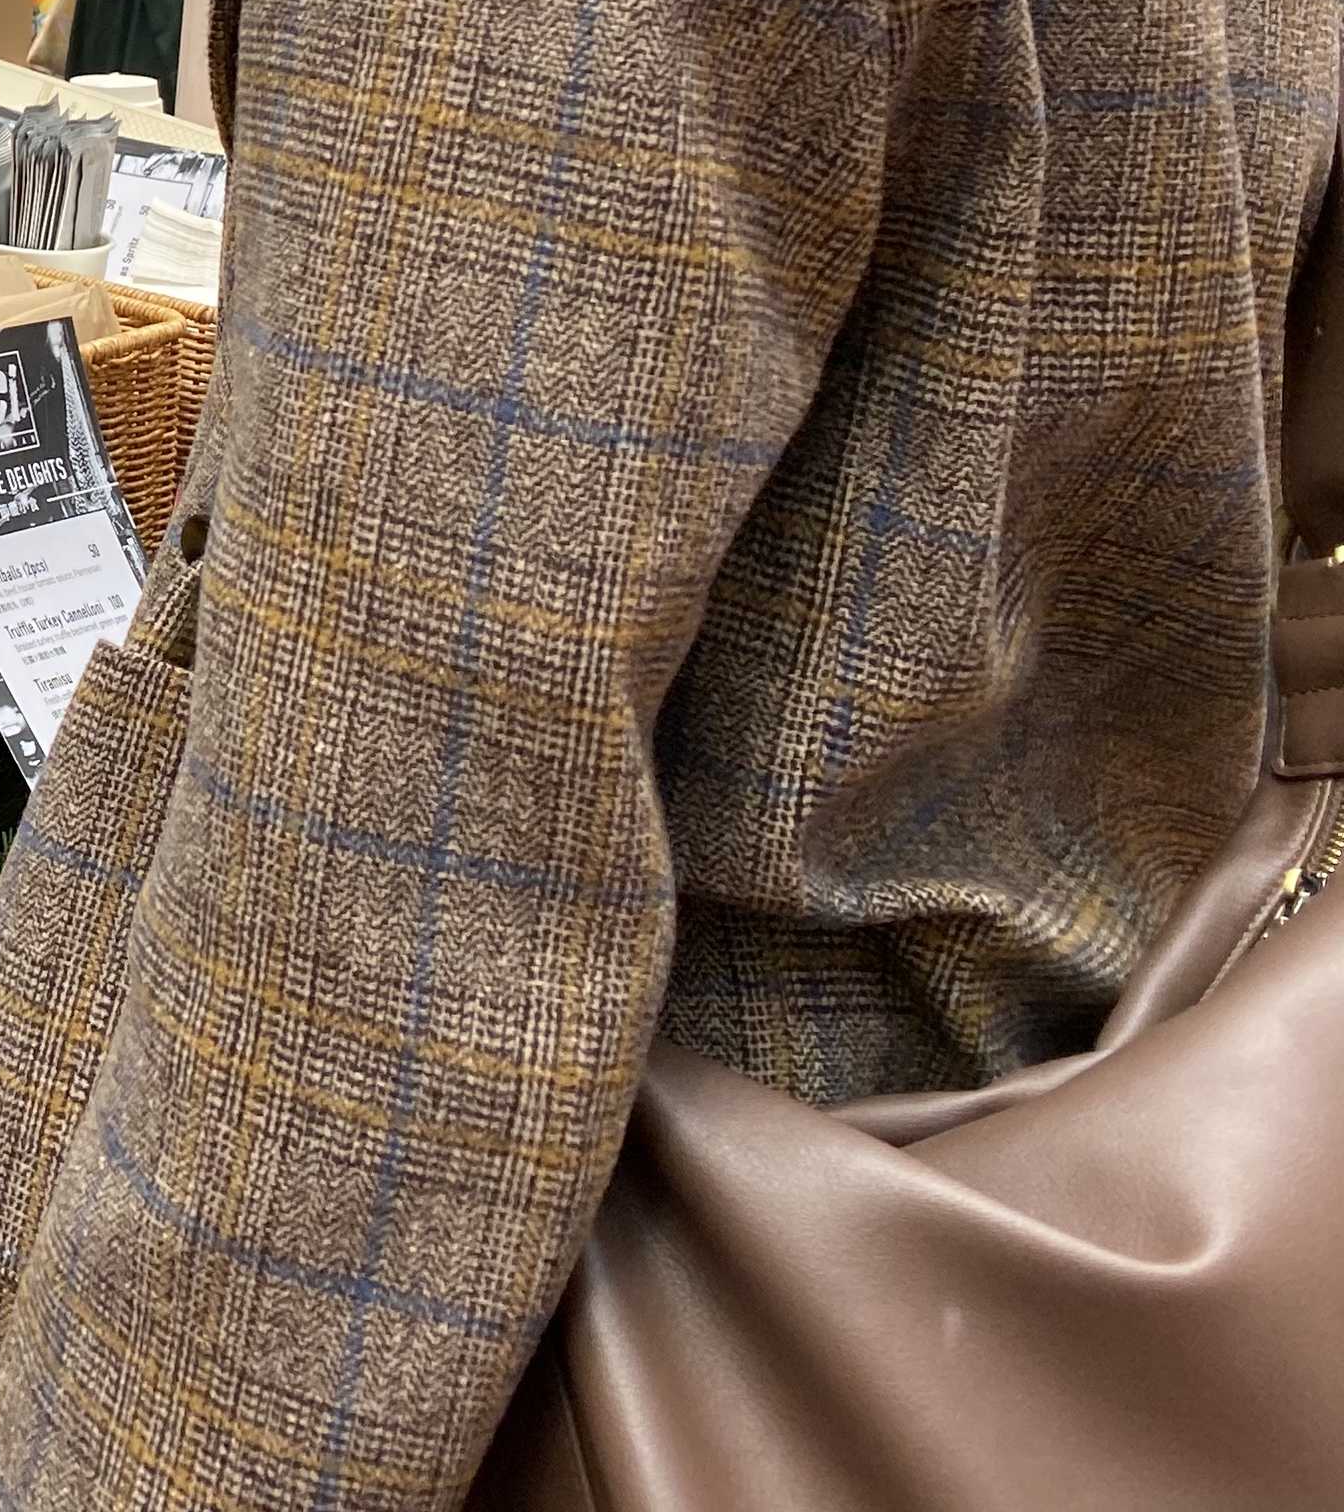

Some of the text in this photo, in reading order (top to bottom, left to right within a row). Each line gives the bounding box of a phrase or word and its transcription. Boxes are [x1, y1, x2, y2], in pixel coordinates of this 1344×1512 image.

[5, 457, 68, 494] DELIGHTS
[22, 557, 49, 579] (2pcs)
[88, 543, 101, 559] 50
[4, 619, 36, 640] Truffle
[32, 613, 63, 632] Turkey
[61, 599, 105, 625] Cannelloni
[33, 672, 74, 694] Tiramisu
